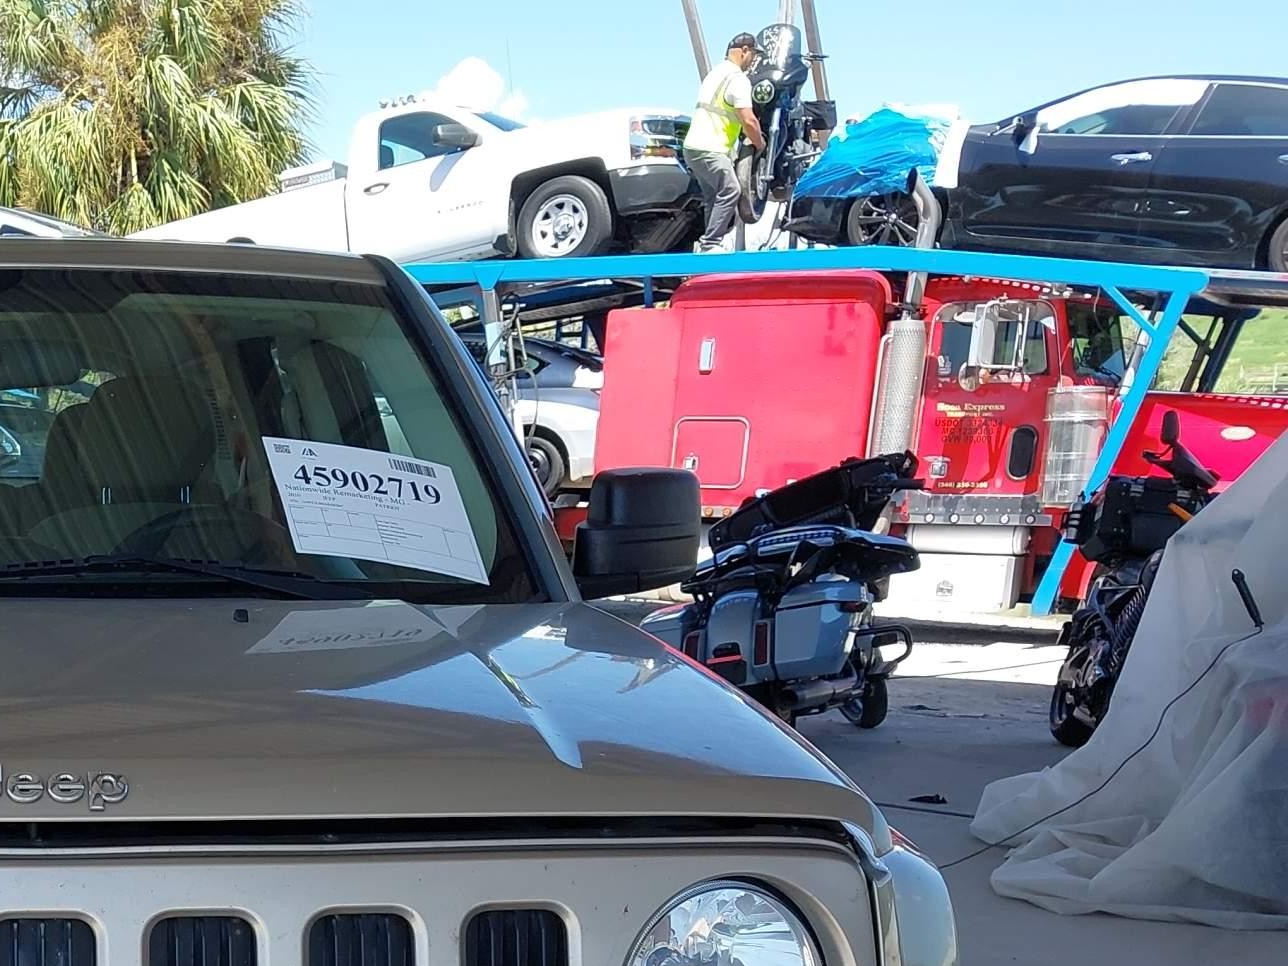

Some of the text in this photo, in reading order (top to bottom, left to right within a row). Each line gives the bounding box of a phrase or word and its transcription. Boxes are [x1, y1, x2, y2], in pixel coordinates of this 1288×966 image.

[964, 403, 1005, 412] Express
[284, 483, 332, 495] Nationwide
[333, 489, 384, 504] Remarketing
[294, 464, 441, 505] 45902719
